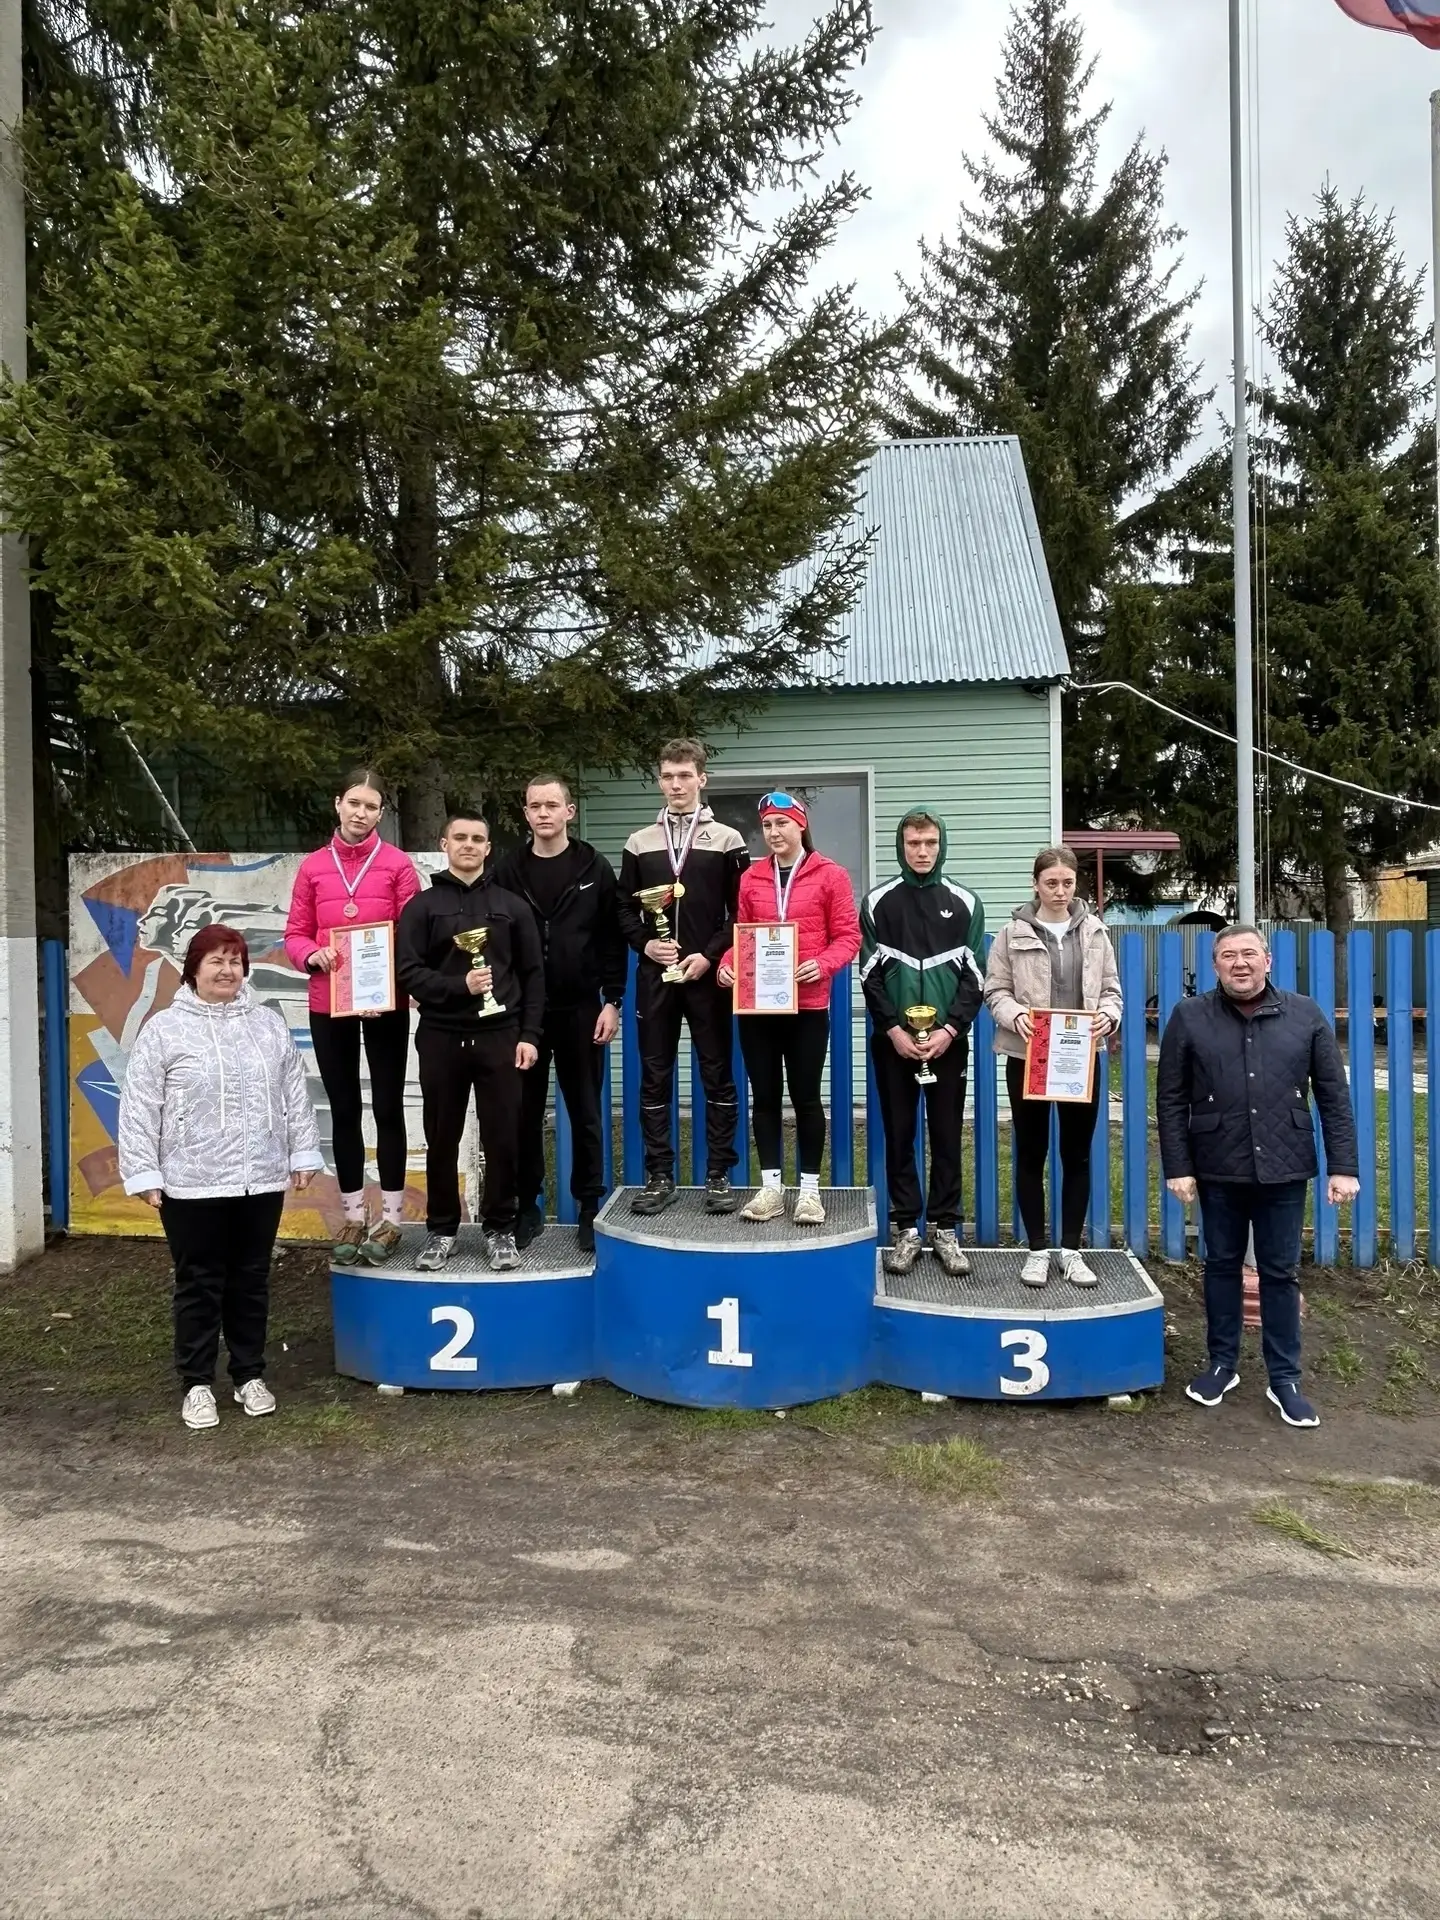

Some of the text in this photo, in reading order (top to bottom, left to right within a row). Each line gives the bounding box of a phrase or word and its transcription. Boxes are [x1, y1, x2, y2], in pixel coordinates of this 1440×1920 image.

[430, 1305, 478, 1371] 2
[707, 1297, 753, 1367] 1
[1000, 1329, 1050, 1395] 3
